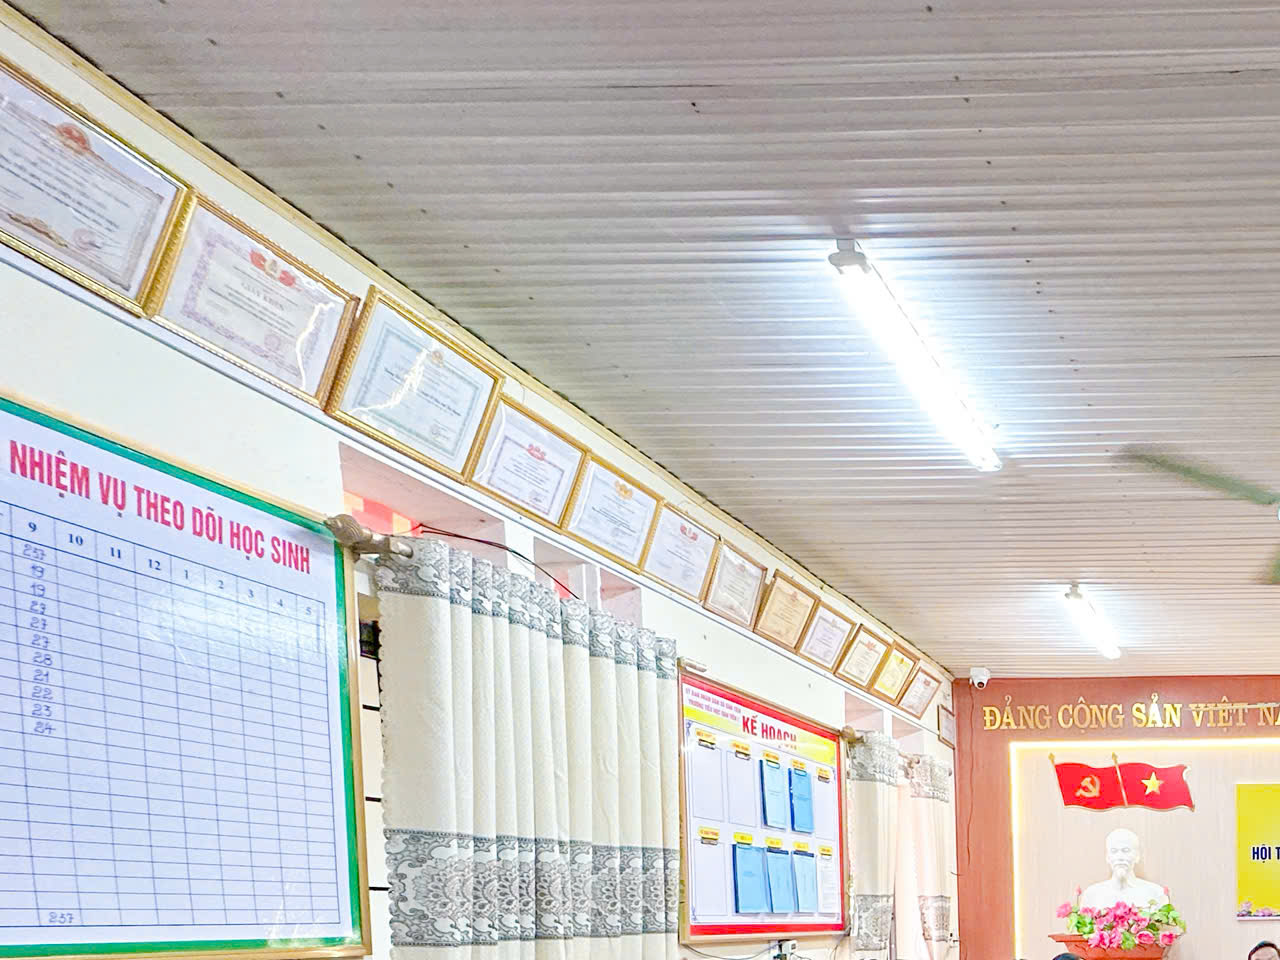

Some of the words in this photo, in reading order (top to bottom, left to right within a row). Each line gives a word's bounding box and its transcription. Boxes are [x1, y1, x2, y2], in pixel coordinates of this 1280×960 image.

[10, 439, 91, 499] NHIỆM
[98, 472, 126, 517] VỤ
[133, 485, 185, 531] THEO
[192, 506, 223, 545] DÕI
[230, 520, 265, 560] HỌC
[271, 539, 311, 575] SINH
[28, 522, 37, 533] 9
[68, 533, 84, 546] 10
[110, 546, 122, 560] 11
[148, 558, 162, 571] 12
[184, 569, 189, 580] 1
[217, 580, 225, 590] 2
[249, 588, 254, 598] 3
[276, 598, 284, 607] 4
[306, 607, 312, 616] 5
[742, 714, 758, 736] KẾ
[983, 695, 1053, 731] ĐẢNG
[1057, 696, 1125, 734] CỘNG
[1132, 692, 1183, 729] SẢN
[1189, 696, 1249, 732] VIỆT
[1252, 844, 1271, 863] HỘI
